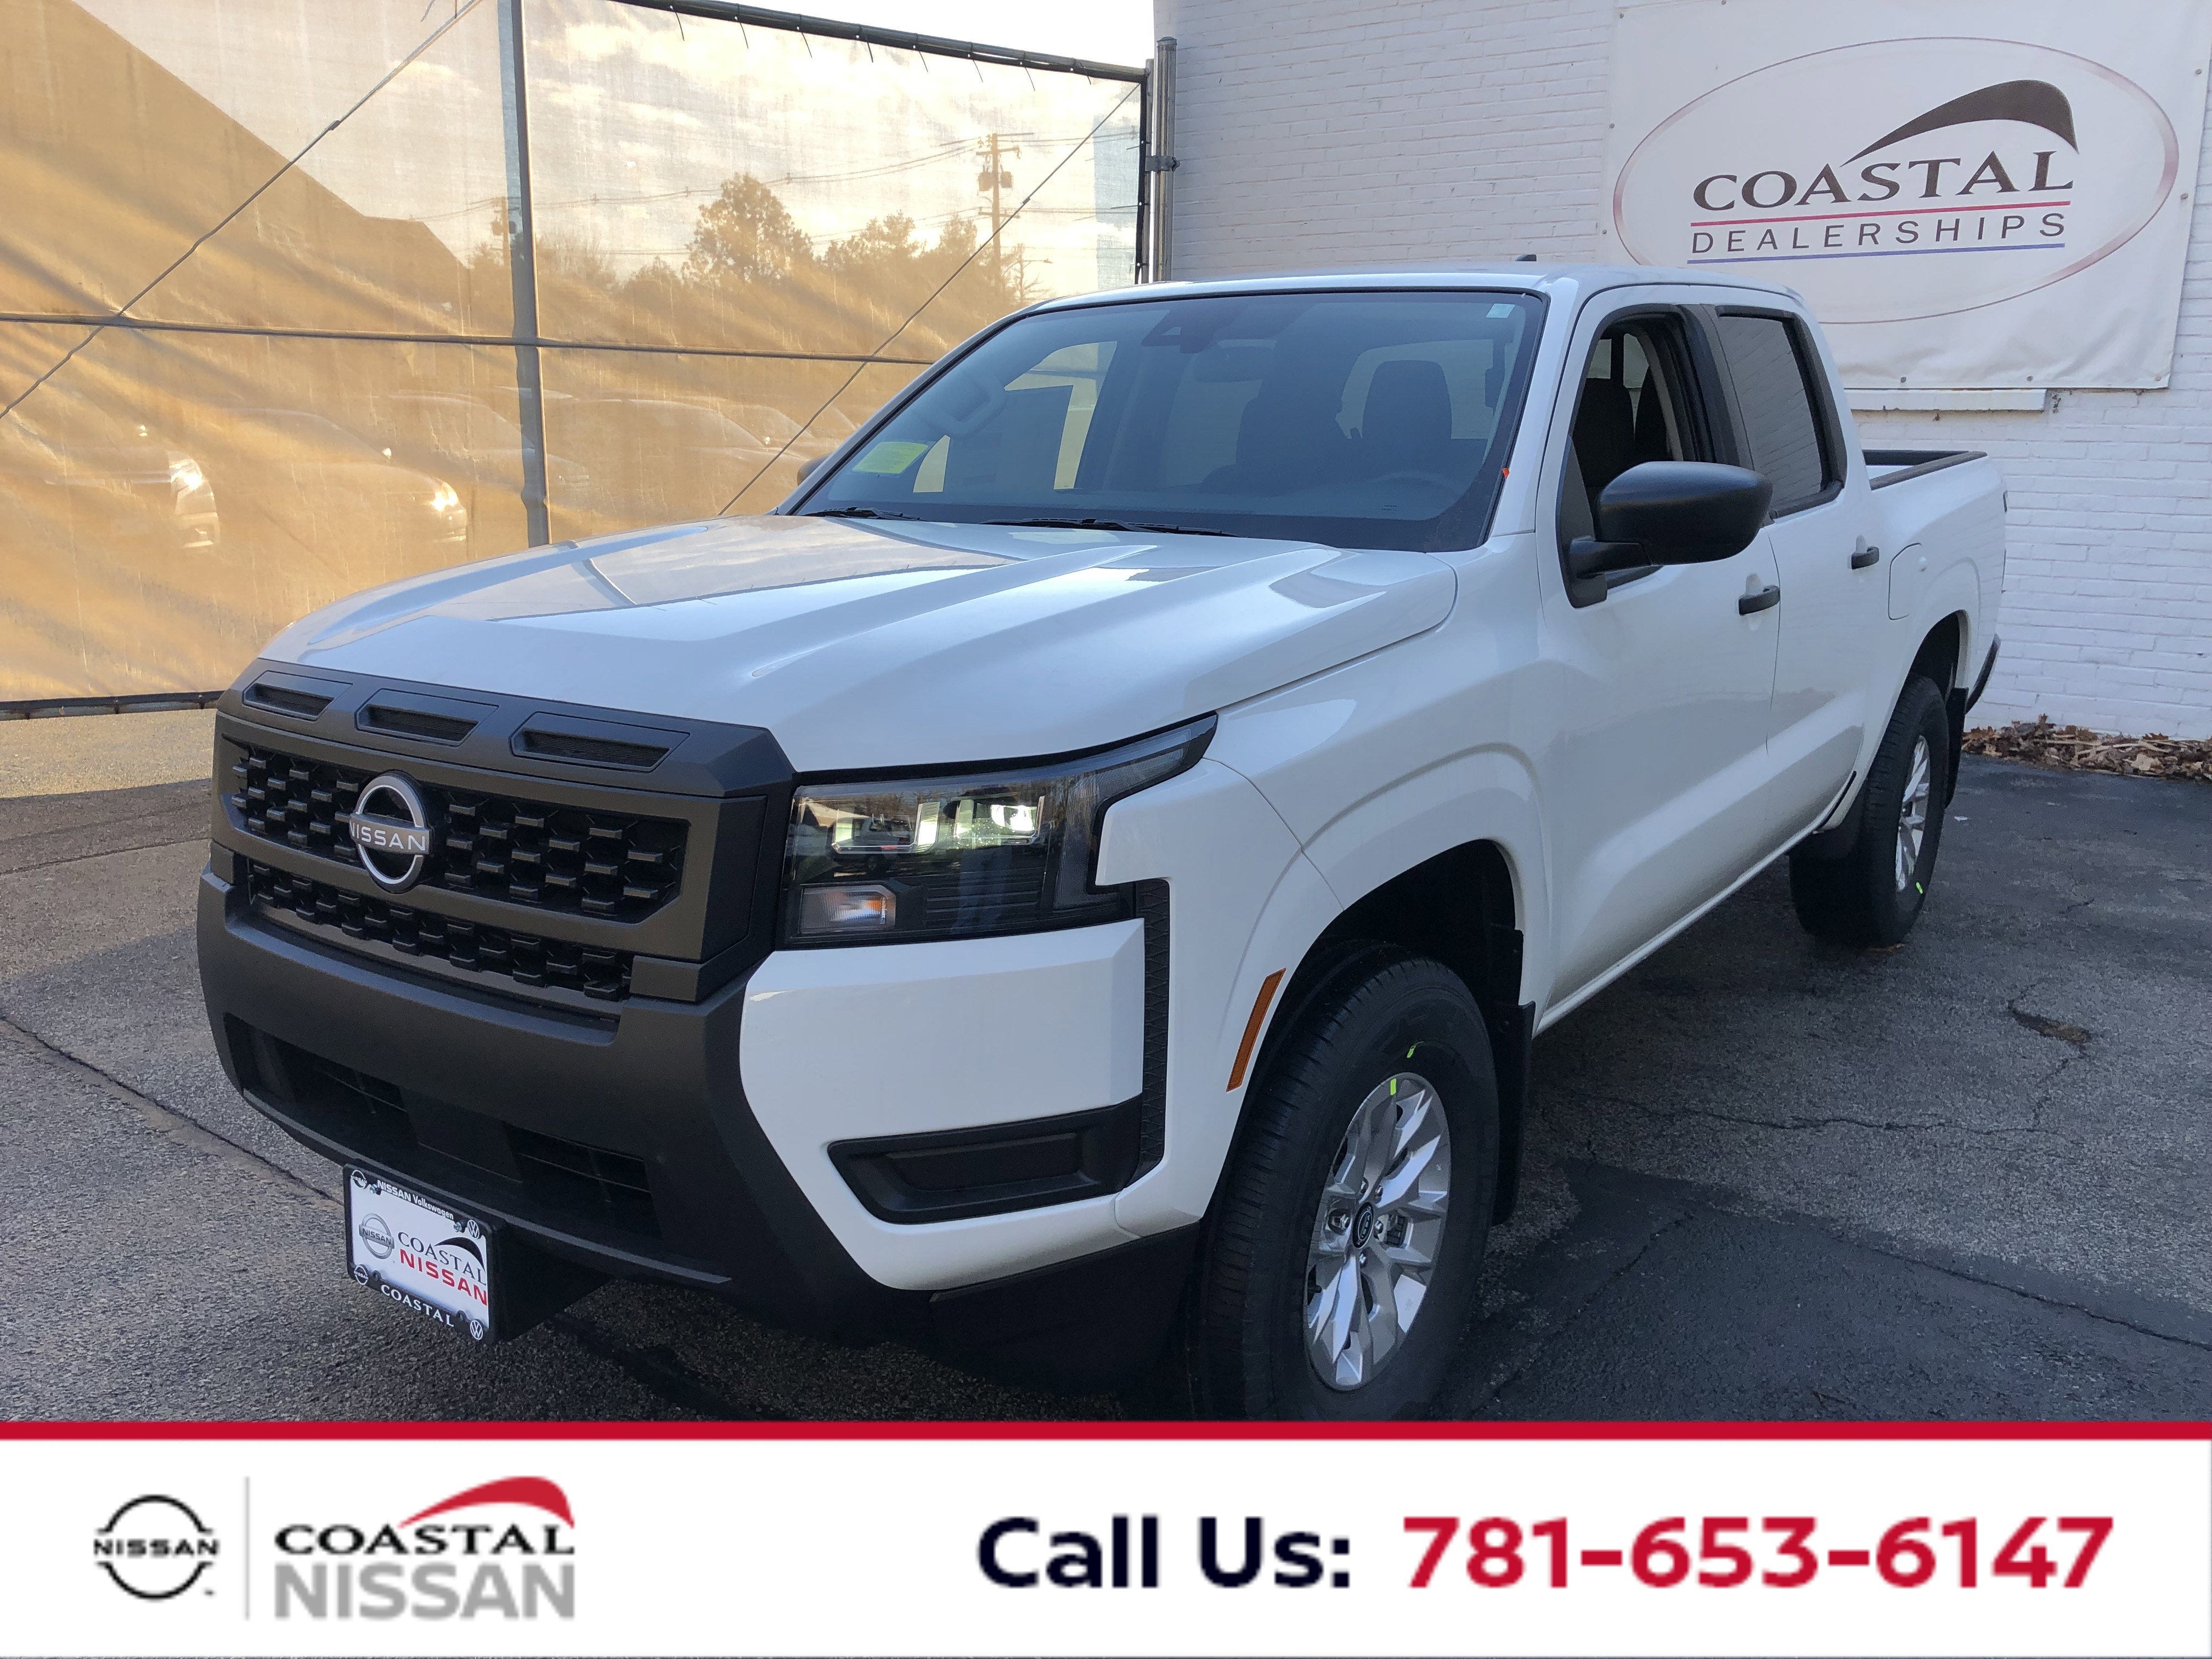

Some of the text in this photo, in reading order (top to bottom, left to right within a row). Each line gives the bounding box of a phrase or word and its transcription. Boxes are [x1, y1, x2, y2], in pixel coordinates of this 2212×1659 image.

[1693, 150, 2074, 211] COASTAL
[1691, 212, 2066, 254] DEALERSHIPS
[349, 822, 426, 851] NISSAN
[377, 1180, 454, 1220] NISSAN Volkswagen
[362, 1228, 391, 1245] NISSAN
[398, 1232, 487, 1286] COASTAL
[399, 1248, 487, 1306] NISSAN
[381, 1284, 454, 1327] COASTAL
